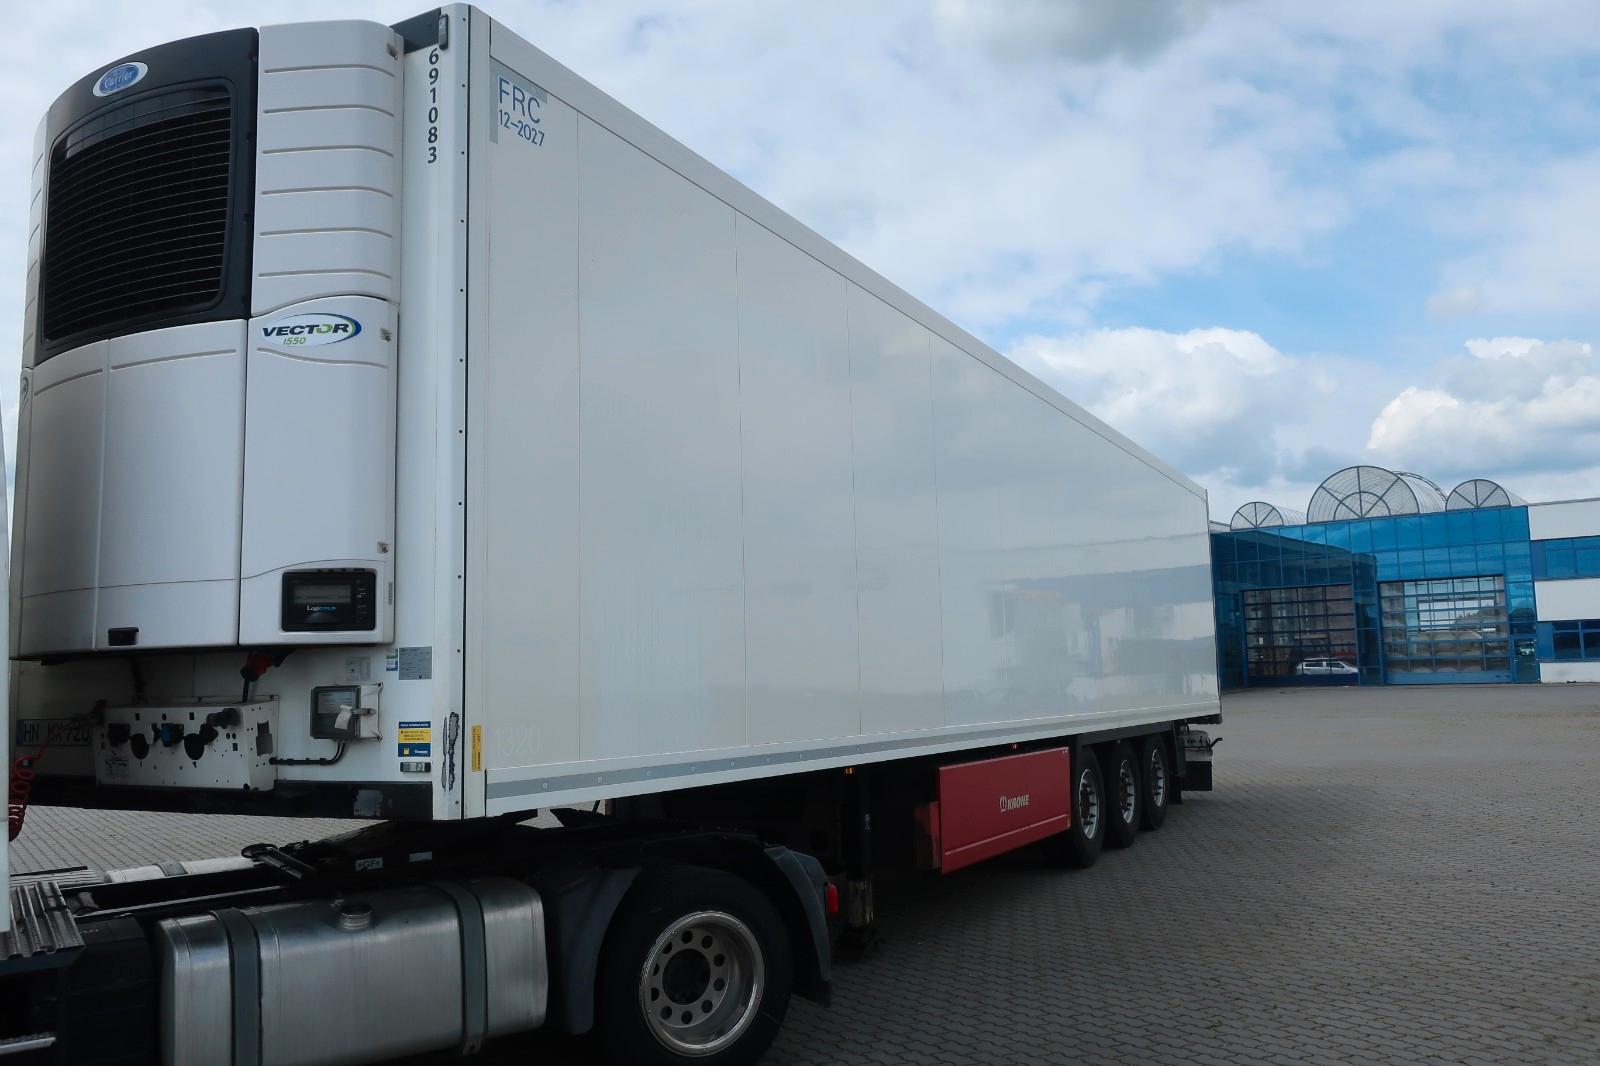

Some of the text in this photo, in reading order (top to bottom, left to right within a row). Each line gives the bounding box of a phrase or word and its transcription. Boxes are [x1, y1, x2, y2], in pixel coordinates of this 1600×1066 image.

[427, 47, 440, 164] 691083
[498, 76, 541, 124] FRC
[498, 109, 545, 147] 12-2027
[262, 323, 349, 337] VECTOR
[283, 337, 306, 345] 1550
[1007, 794, 1030, 811] KRONE
